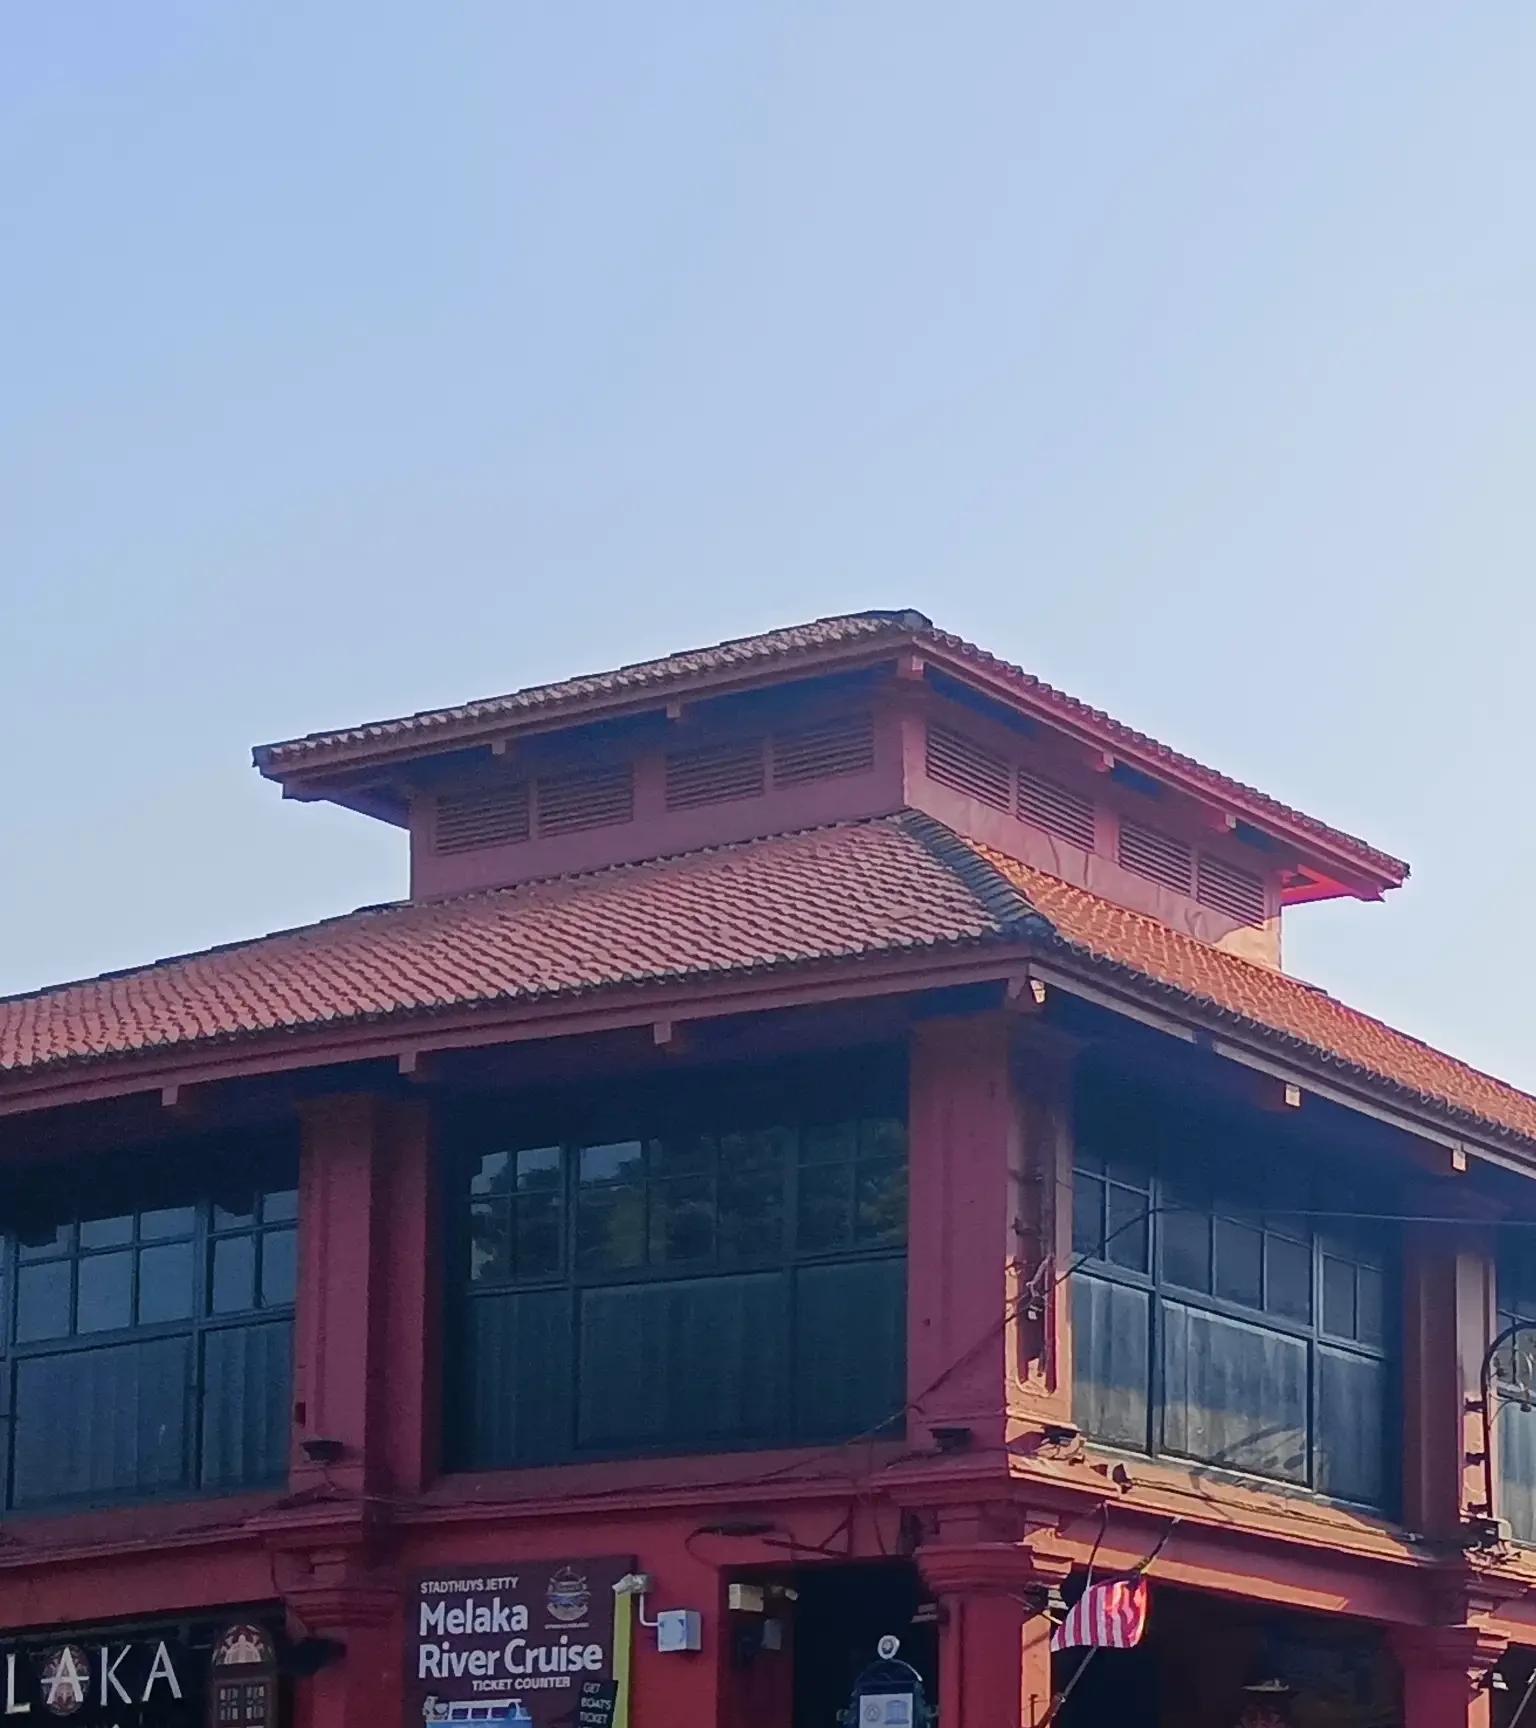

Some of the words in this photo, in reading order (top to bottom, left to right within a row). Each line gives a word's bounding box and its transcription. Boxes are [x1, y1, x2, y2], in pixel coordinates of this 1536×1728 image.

[421, 1579, 484, 1595] STADTHUYS
[485, 1576, 520, 1592] JETTY
[419, 1597, 529, 1637] Melaka
[419, 1641, 500, 1679] River
[504, 1635, 603, 1675] Cruise
[472, 1678, 513, 1692] TICKET
[514, 1676, 571, 1691] COUNTER
